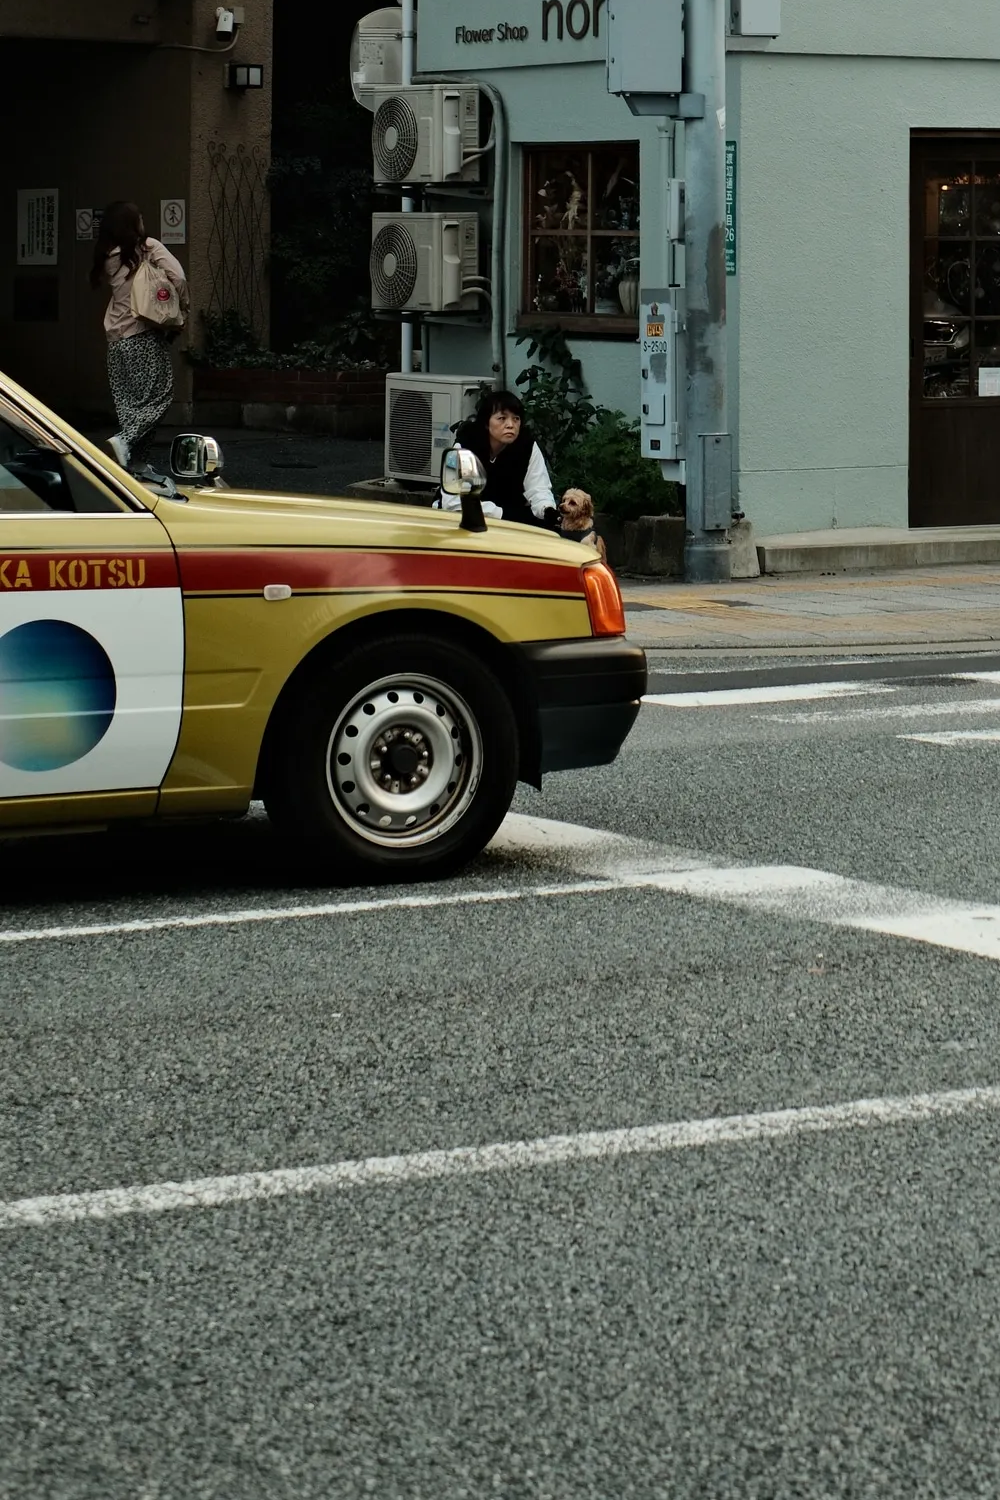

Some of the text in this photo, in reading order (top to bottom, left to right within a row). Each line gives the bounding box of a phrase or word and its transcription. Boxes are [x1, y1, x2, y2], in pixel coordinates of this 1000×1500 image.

[455, 25, 495, 44] Flower
[497, 21, 529, 42] Shop
[48, 558, 146, 588] KOTSU
